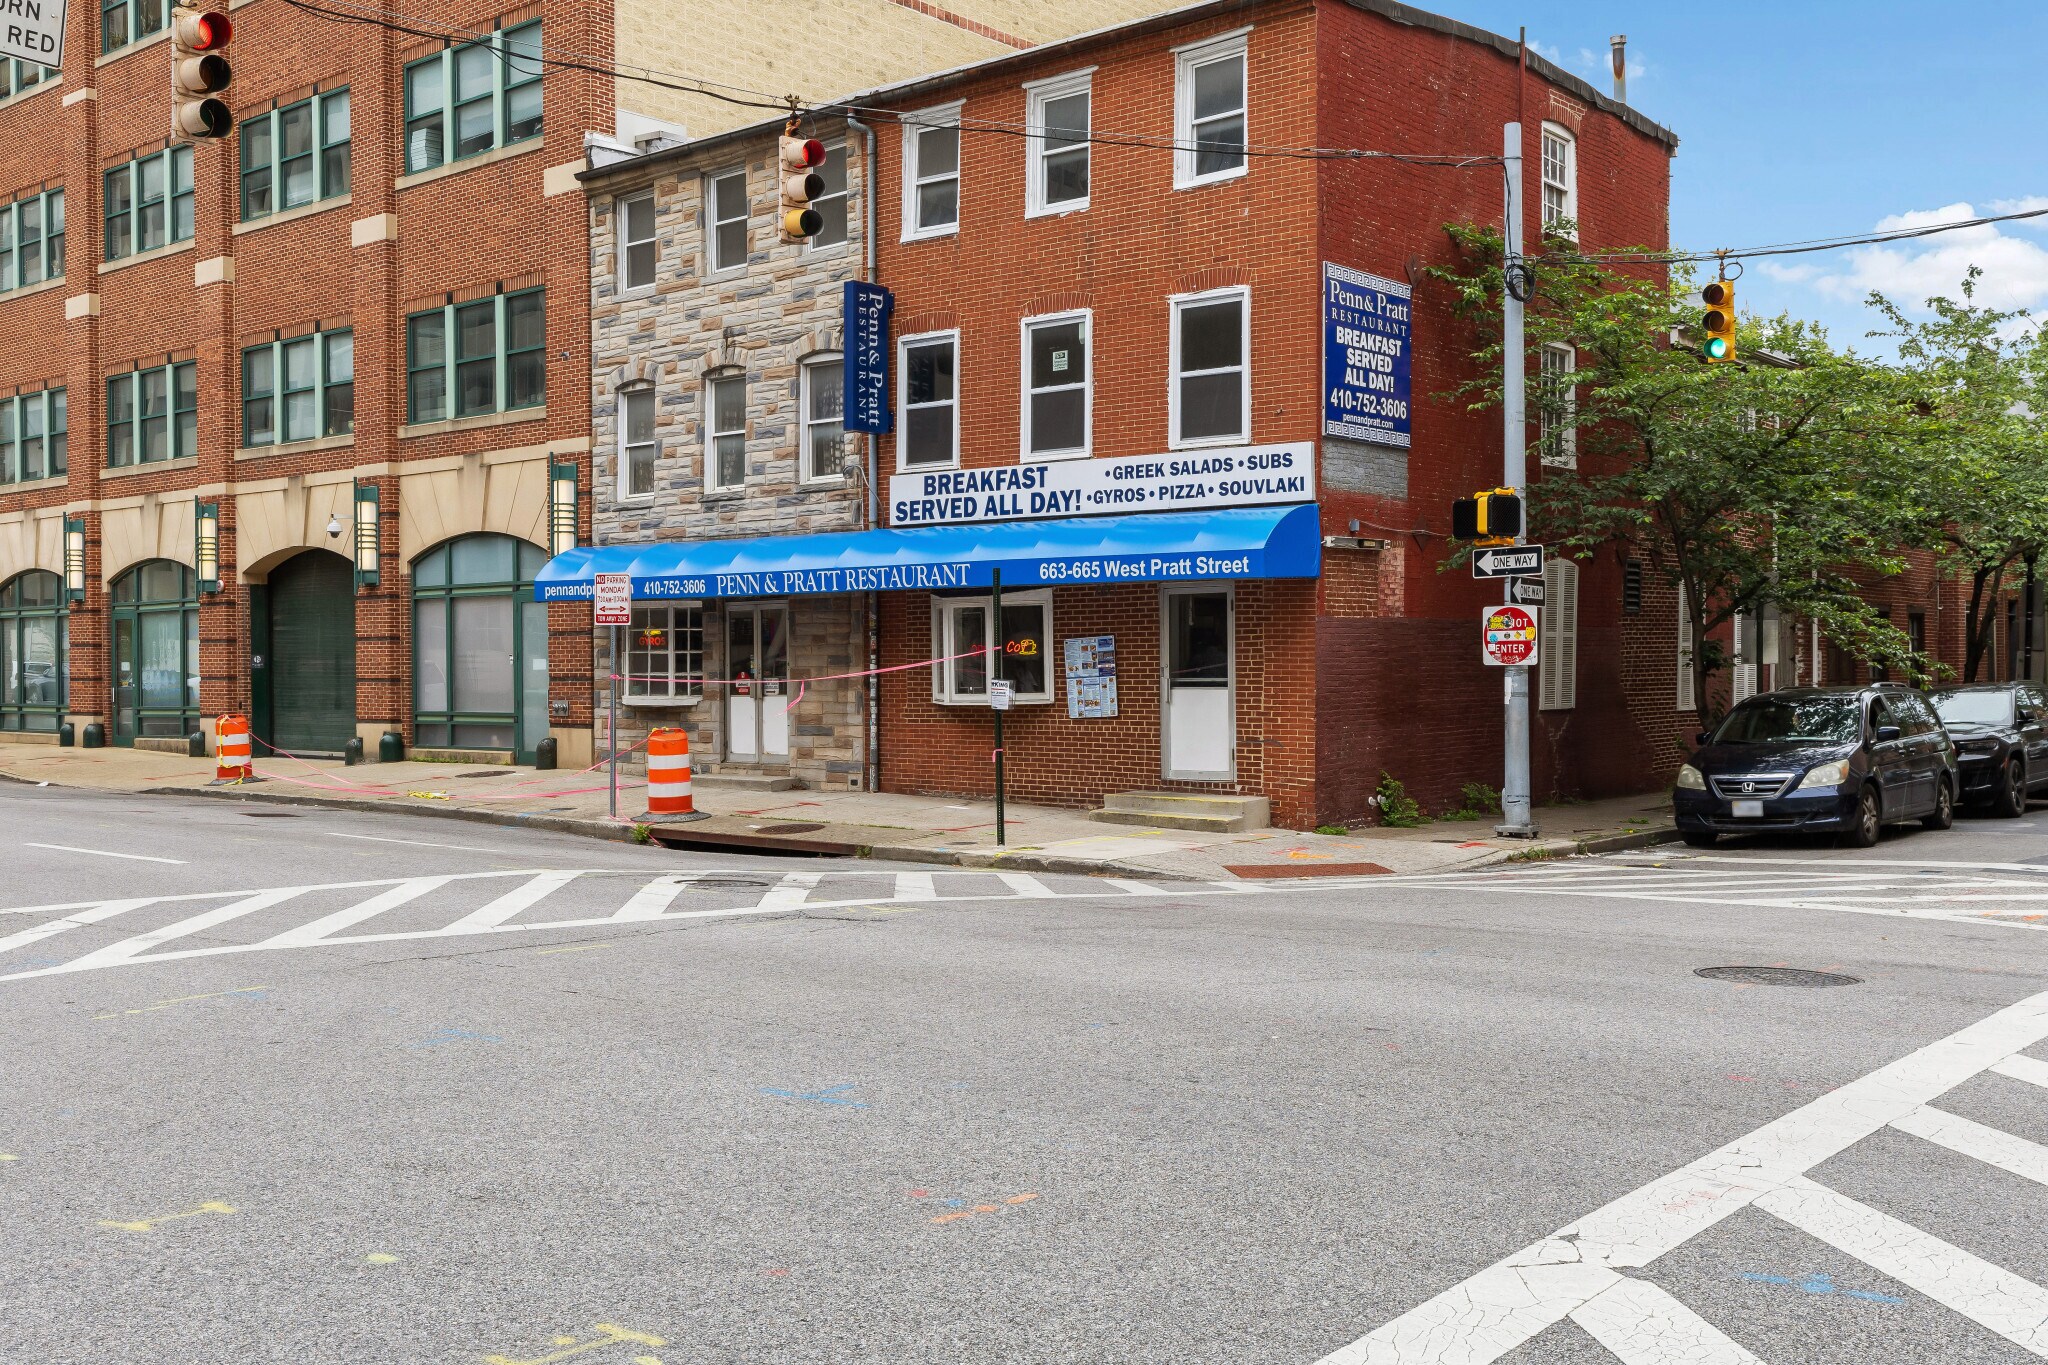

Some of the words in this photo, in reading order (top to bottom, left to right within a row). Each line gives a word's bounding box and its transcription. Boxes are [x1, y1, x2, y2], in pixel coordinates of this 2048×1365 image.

[0, 0, 41, 21] RN
[7, 24, 55, 53] RED
[1376, 292, 1408, 322] Pratt
[1331, 307, 1406, 337] RESTAURANT
[1336, 325, 1402, 357] BREAKFAST
[858, 292, 867, 422] RESTAURANT
[1346, 348, 1392, 373] SERVED
[1344, 367, 1366, 388] ALL
[1368, 373, 1394, 393] DAY!
[868, 371, 883, 427] Pratt
[1330, 387, 1407, 420] 410-752-3606
[1342, 413, 1394, 430] pennandpratt.com
[1112, 462, 1165, 480] GREEK
[1169, 457, 1234, 477] SALADS
[1246, 452, 1293, 470] SUBS
[923, 466, 1049, 497] BREAKFAST
[1093, 487, 1146, 504] GYROS
[1158, 483, 1206, 500] PIZZA
[1218, 476, 1305, 497] SOUVLAKI
[895, 496, 978, 522] SERVED
[983, 493, 1024, 517] ALL
[1030, 489, 1081, 514] DAY!
[1039, 561, 1100, 580] 663-665
[1103, 560, 1146, 578] West
[1150, 558, 1192, 576] Pratt
[1196, 555, 1249, 575] Street
[1493, 556, 1511, 568] ONE
[1514, 555, 1534, 567] WAY
[596, 575, 605, 584] NO
[606, 576, 627, 584] PARKING
[600, 586, 626, 594] MONDAY
[644, 579, 706, 595] 410-752-3606
[716, 574, 760, 596] PENN
[764, 573, 780, 593] &
[782, 570, 841, 593] PRATT
[845, 563, 971, 591] RESTAURANT
[1520, 585, 1531, 597] ONE
[1531, 586, 1543, 598] WAY
[638, 636, 666, 646] GYROS
[1495, 643, 1525, 654] ENTER
